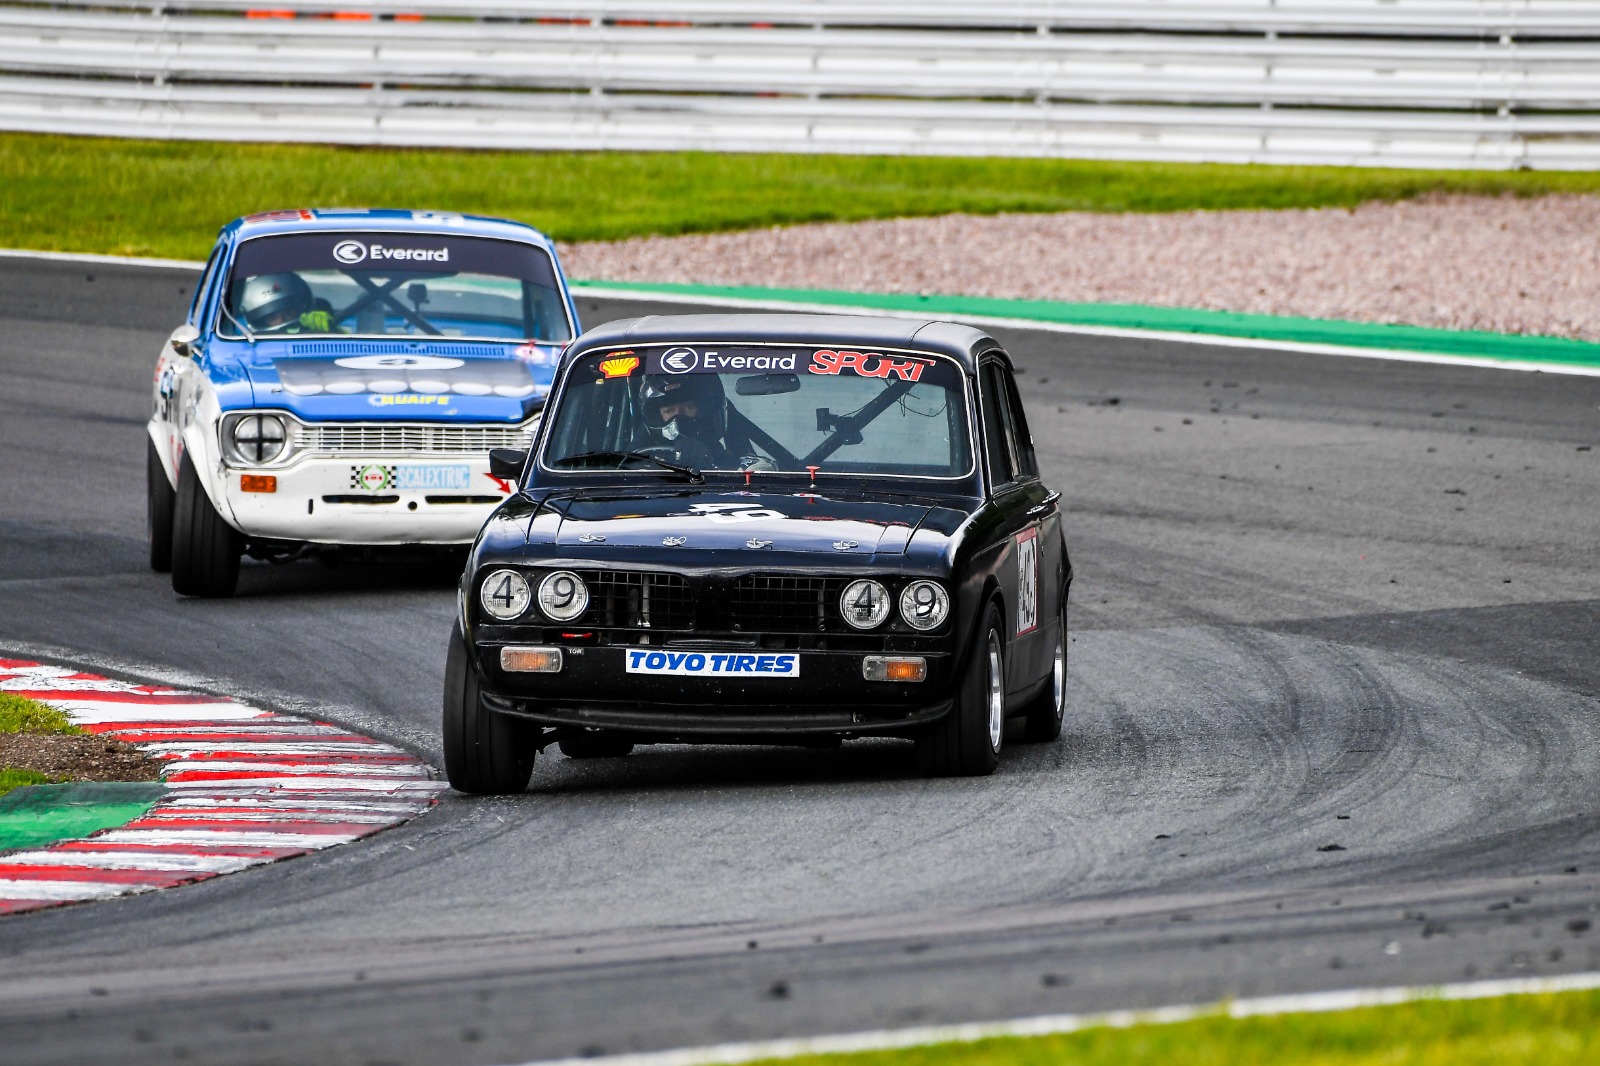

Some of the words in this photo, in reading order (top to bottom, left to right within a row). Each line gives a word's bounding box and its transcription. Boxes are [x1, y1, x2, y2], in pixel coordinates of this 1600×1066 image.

[369, 244, 449, 262] Everard
[703, 351, 797, 370] Everard
[808, 349, 937, 382] SPORT
[397, 465, 469, 488] SCALEXTRIC
[492, 575, 515, 609] 4
[552, 576, 576, 609] 9
[853, 583, 876, 618] 4
[913, 584, 937, 617] 9
[629, 651, 706, 671] TOYO
[710, 654, 795, 673] TIRES
